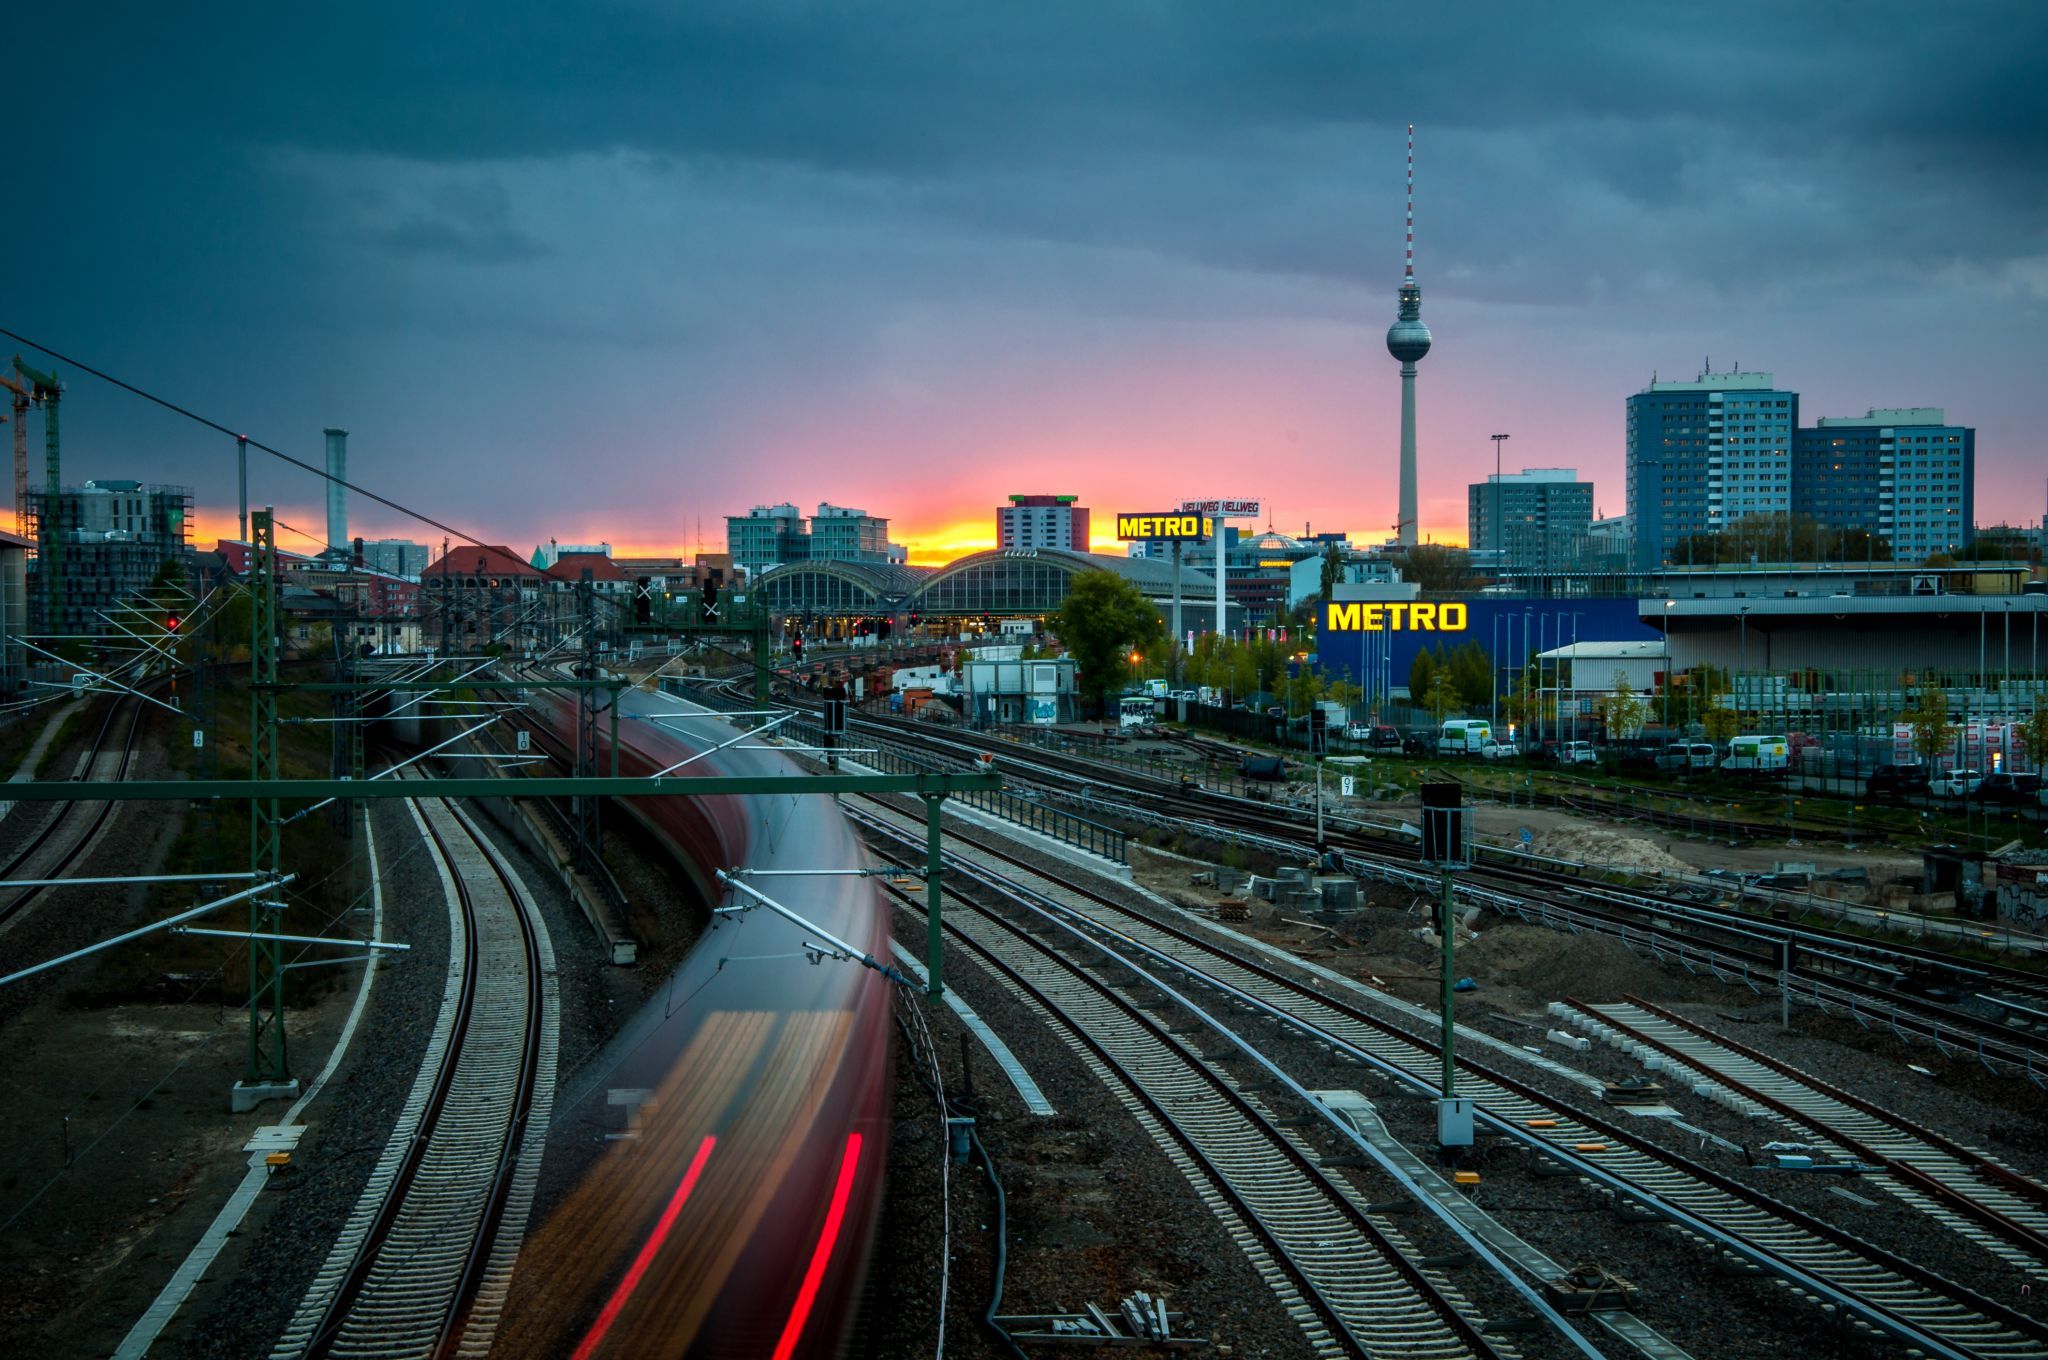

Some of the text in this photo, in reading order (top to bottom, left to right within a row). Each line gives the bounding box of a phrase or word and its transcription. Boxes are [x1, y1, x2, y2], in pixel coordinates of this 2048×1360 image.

[1183, 501, 1219, 512] HELLWEG
[1221, 501, 1259, 512] HELLWEG
[1119, 517, 1198, 537] METRO
[1328, 603, 1467, 631] METRO
